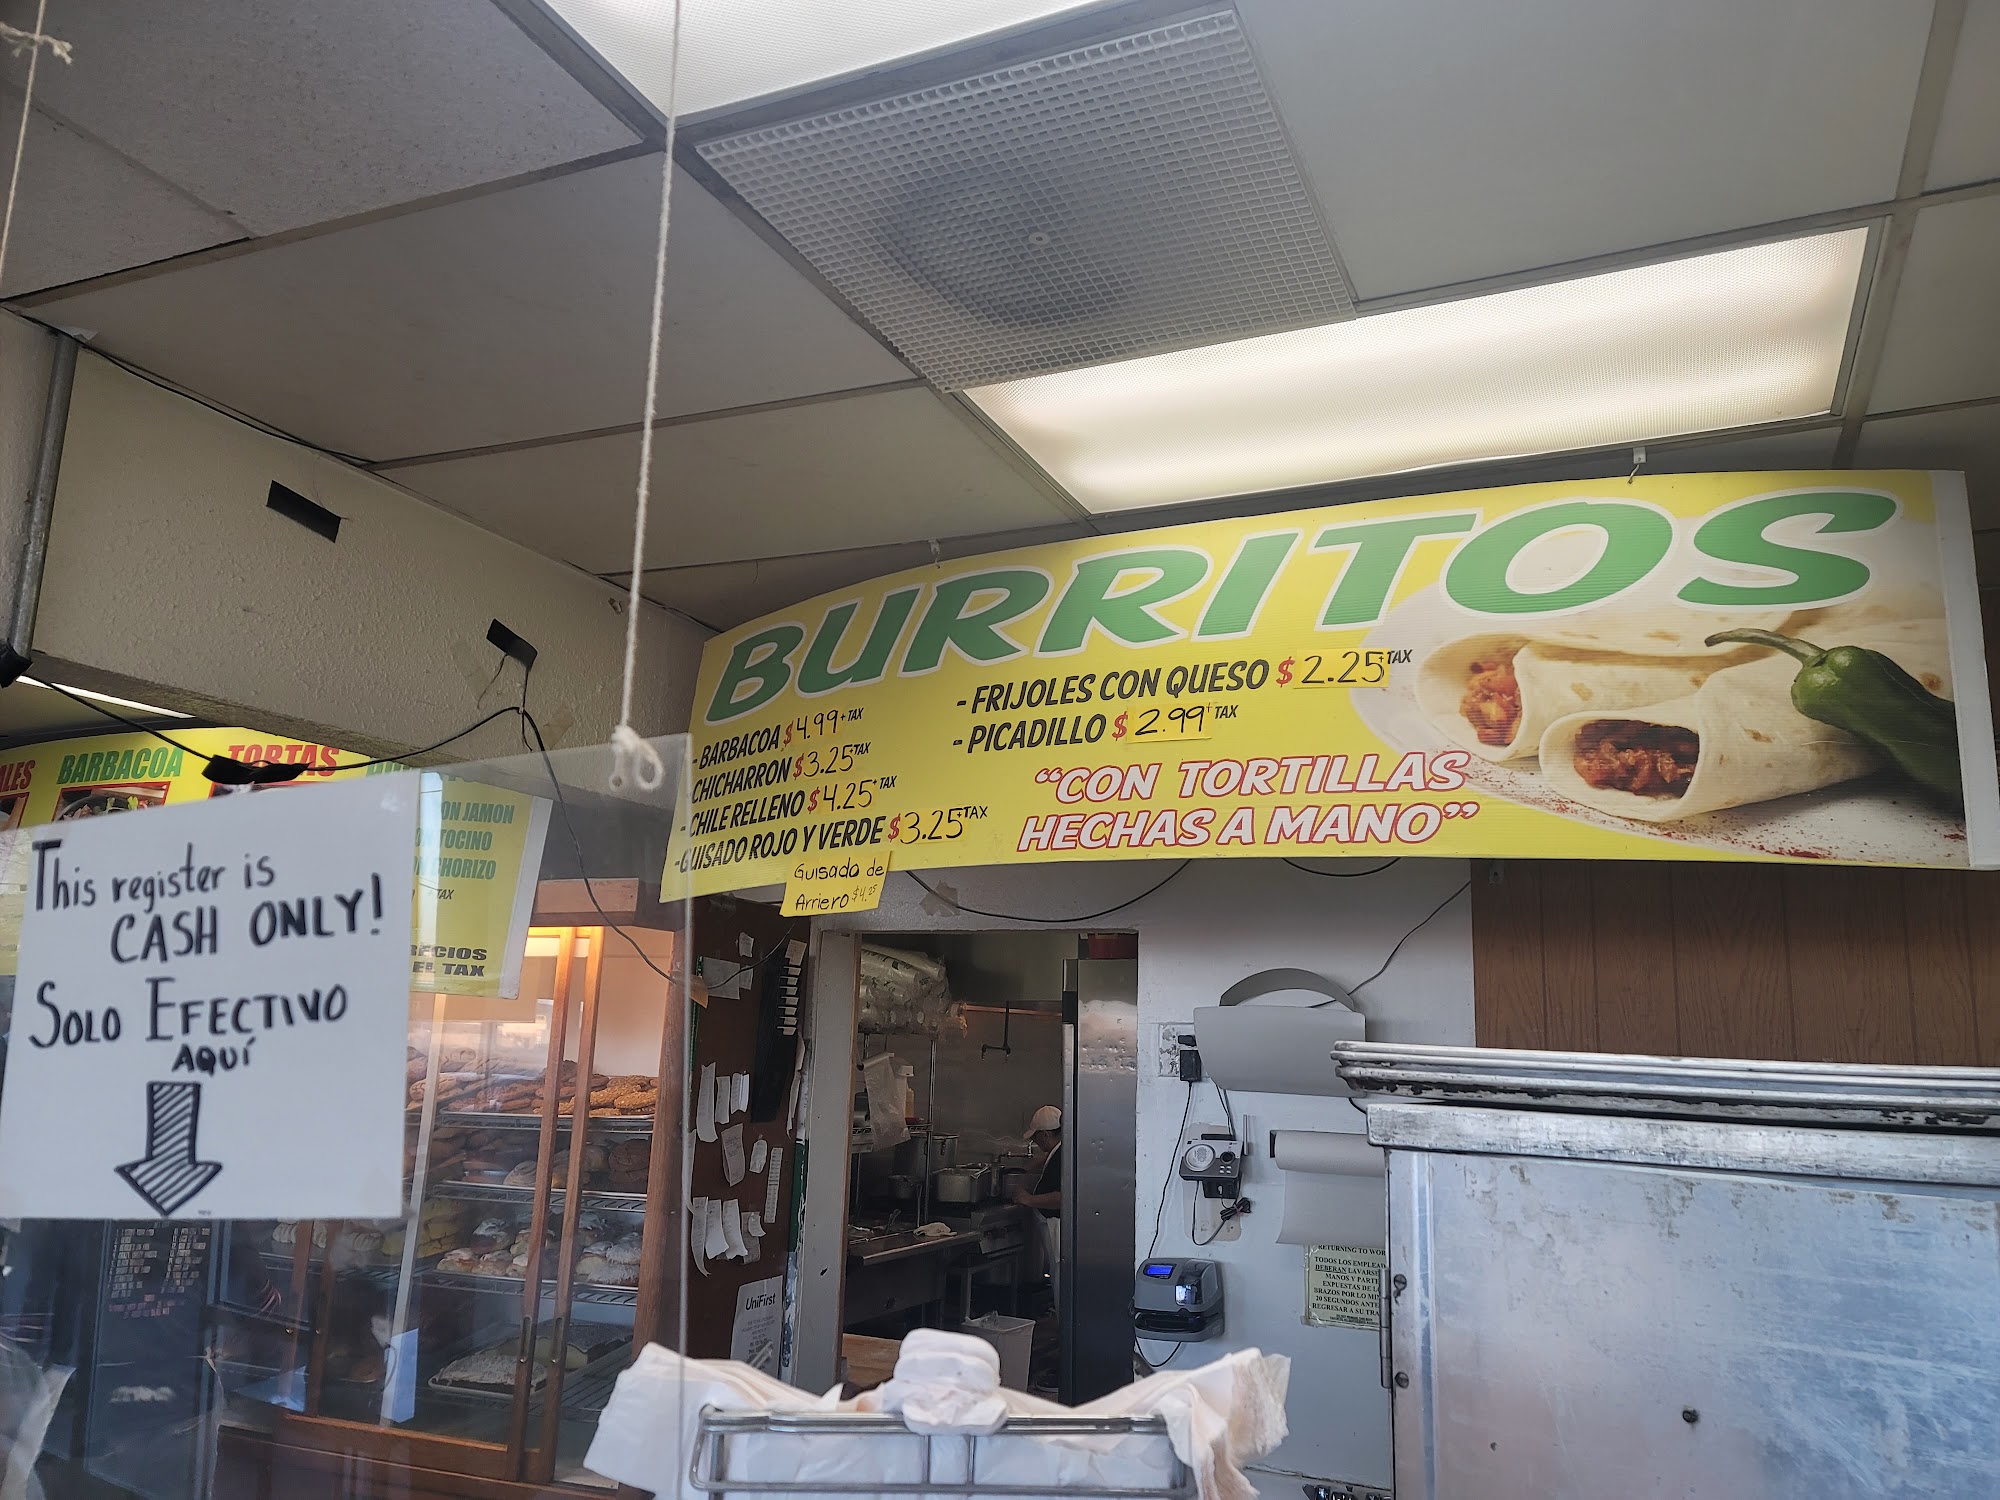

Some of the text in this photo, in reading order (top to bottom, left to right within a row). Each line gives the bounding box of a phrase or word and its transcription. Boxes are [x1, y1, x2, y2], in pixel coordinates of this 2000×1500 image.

[704, 491, 1898, 723] BURRITOS
[971, 676, 1094, 714] FRIJOLES
[1099, 667, 1162, 700] CON
[1165, 658, 1270, 698] QUESO
[699, 724, 781, 770] BARBACOA
[967, 713, 1107, 754] PICADILLO
[56, 747, 184, 785] BARBACOA
[691, 756, 793, 804] CHICHARRON
[1178, 751, 1473, 800] TORTILLAS
[462, 803, 515, 824] JAMON
[689, 805, 732, 838] CHILE
[731, 790, 805, 829] RELLENO
[1017, 807, 1215, 854] HECHAS
[1218, 808, 1257, 846] A
[679, 837, 749, 874] GUISADO
[748, 828, 798, 861] ROJO
[802, 826, 818, 852] Y
[816, 816, 887, 850] VERDE
[31, 839, 275, 915] This register is
[794, 857, 885, 881] Guisado de
[110, 871, 384, 964] CASH ONLY!
[795, 893, 850, 911] Arriero
[442, 963, 485, 977] TAX
[28, 976, 348, 1049] SOLO EFECTIVO
[171, 1036, 256, 1076] AQUÍ
[1315, 1256, 1337, 1264] TODOS
[1338, 1258, 1352, 1266] LOS
[1318, 1245, 1357, 1253] RETURNING
[1314, 1287, 1340, 1296] BRAZOS
[1341, 1290, 1355, 1298] POR
[1357, 1291, 1366, 1299] LO
[1322, 1280, 1361, 1290] EXPUESTAS
[1325, 1273, 1350, 1281] MANOS
[745, 1293, 776, 1310] UniFirst
[1312, 1303, 1348, 1313] REGRESAR
[1323, 1296, 1359, 1306] SEGUNDOS
